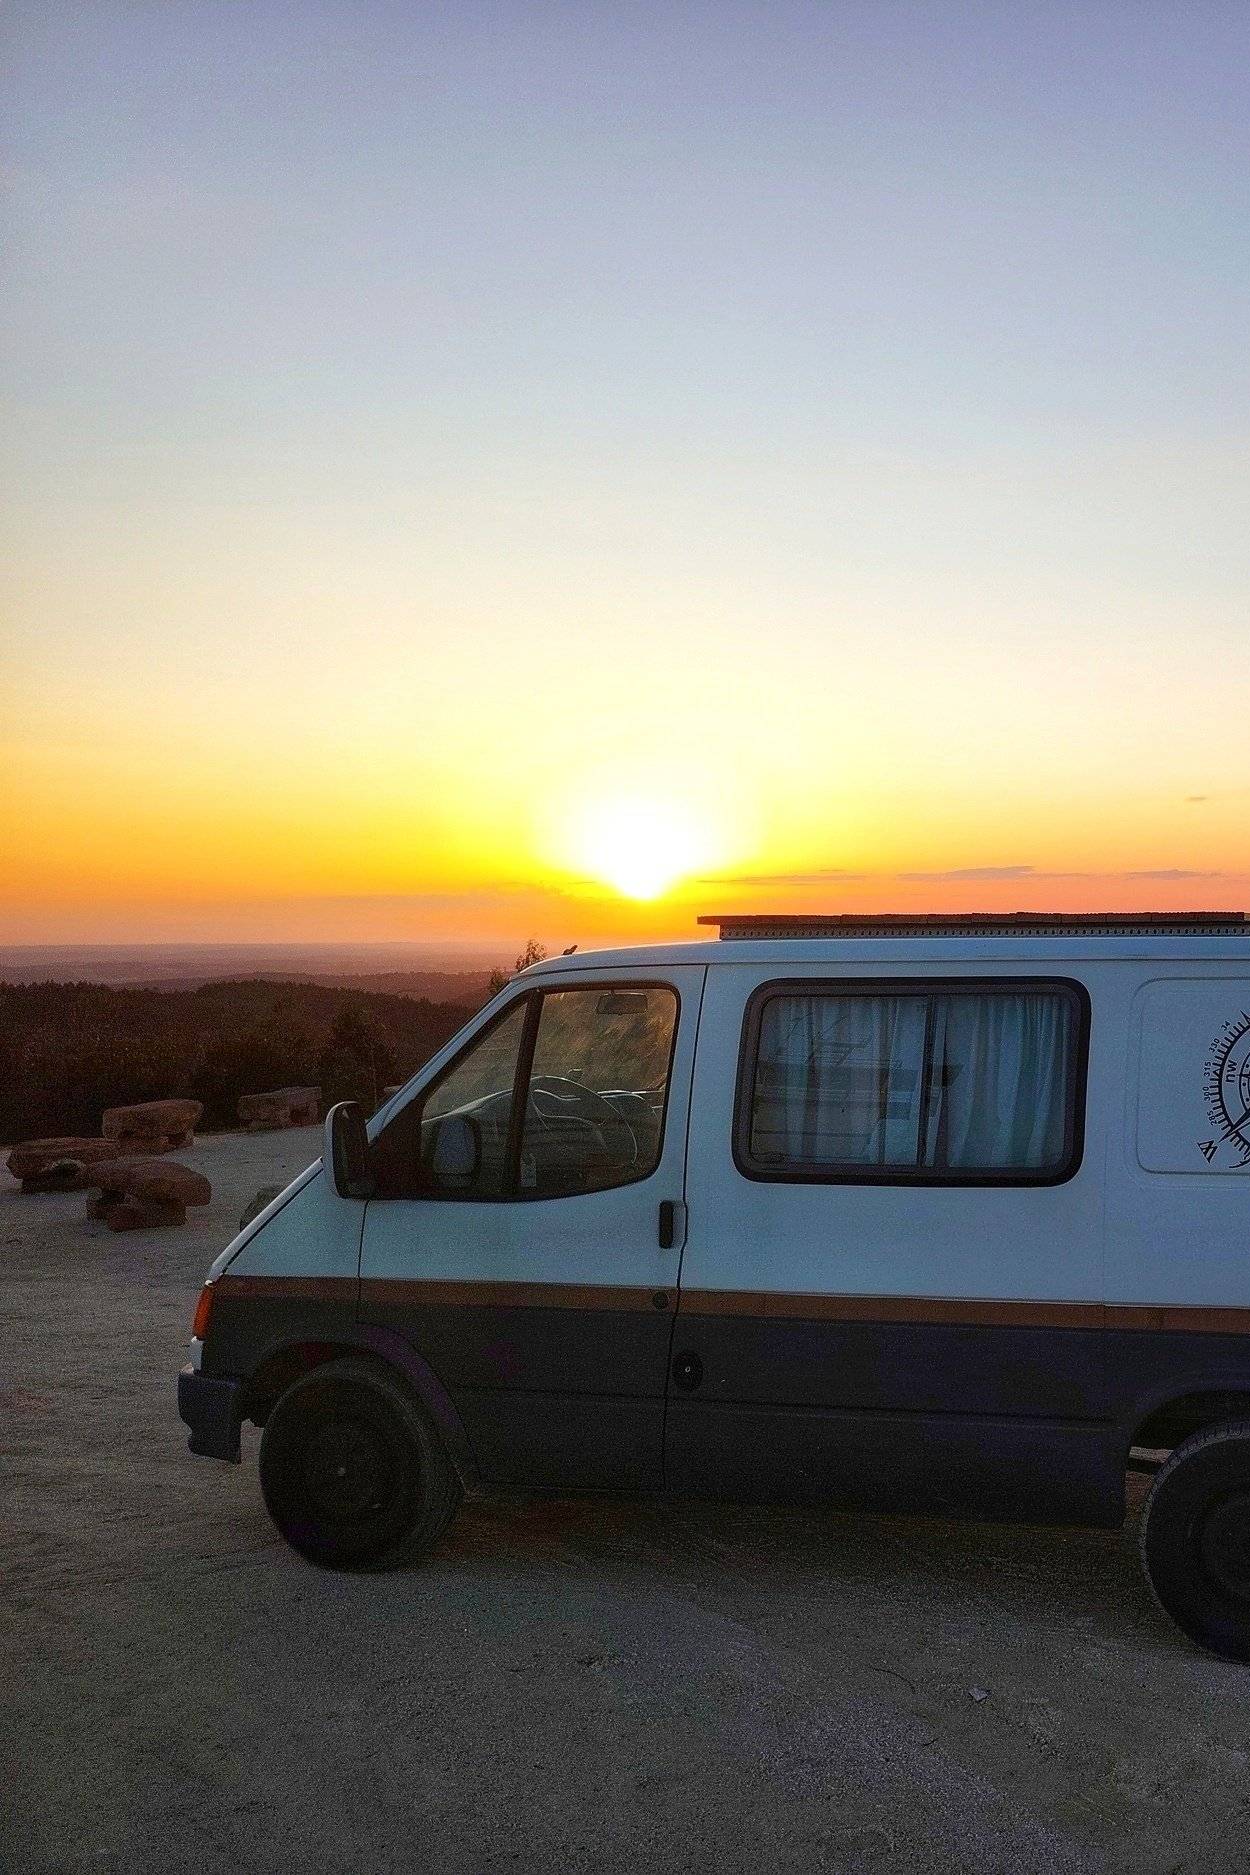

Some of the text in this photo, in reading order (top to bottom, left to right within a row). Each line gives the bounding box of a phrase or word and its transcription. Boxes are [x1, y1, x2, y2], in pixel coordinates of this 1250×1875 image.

[1208, 1038, 1220, 1053] 330
[1203, 1061, 1212, 1077] 315
[1225, 1060, 1238, 1083] nw
[1202, 1086, 1211, 1101] 300
[1206, 1110, 1218, 1126] 285
